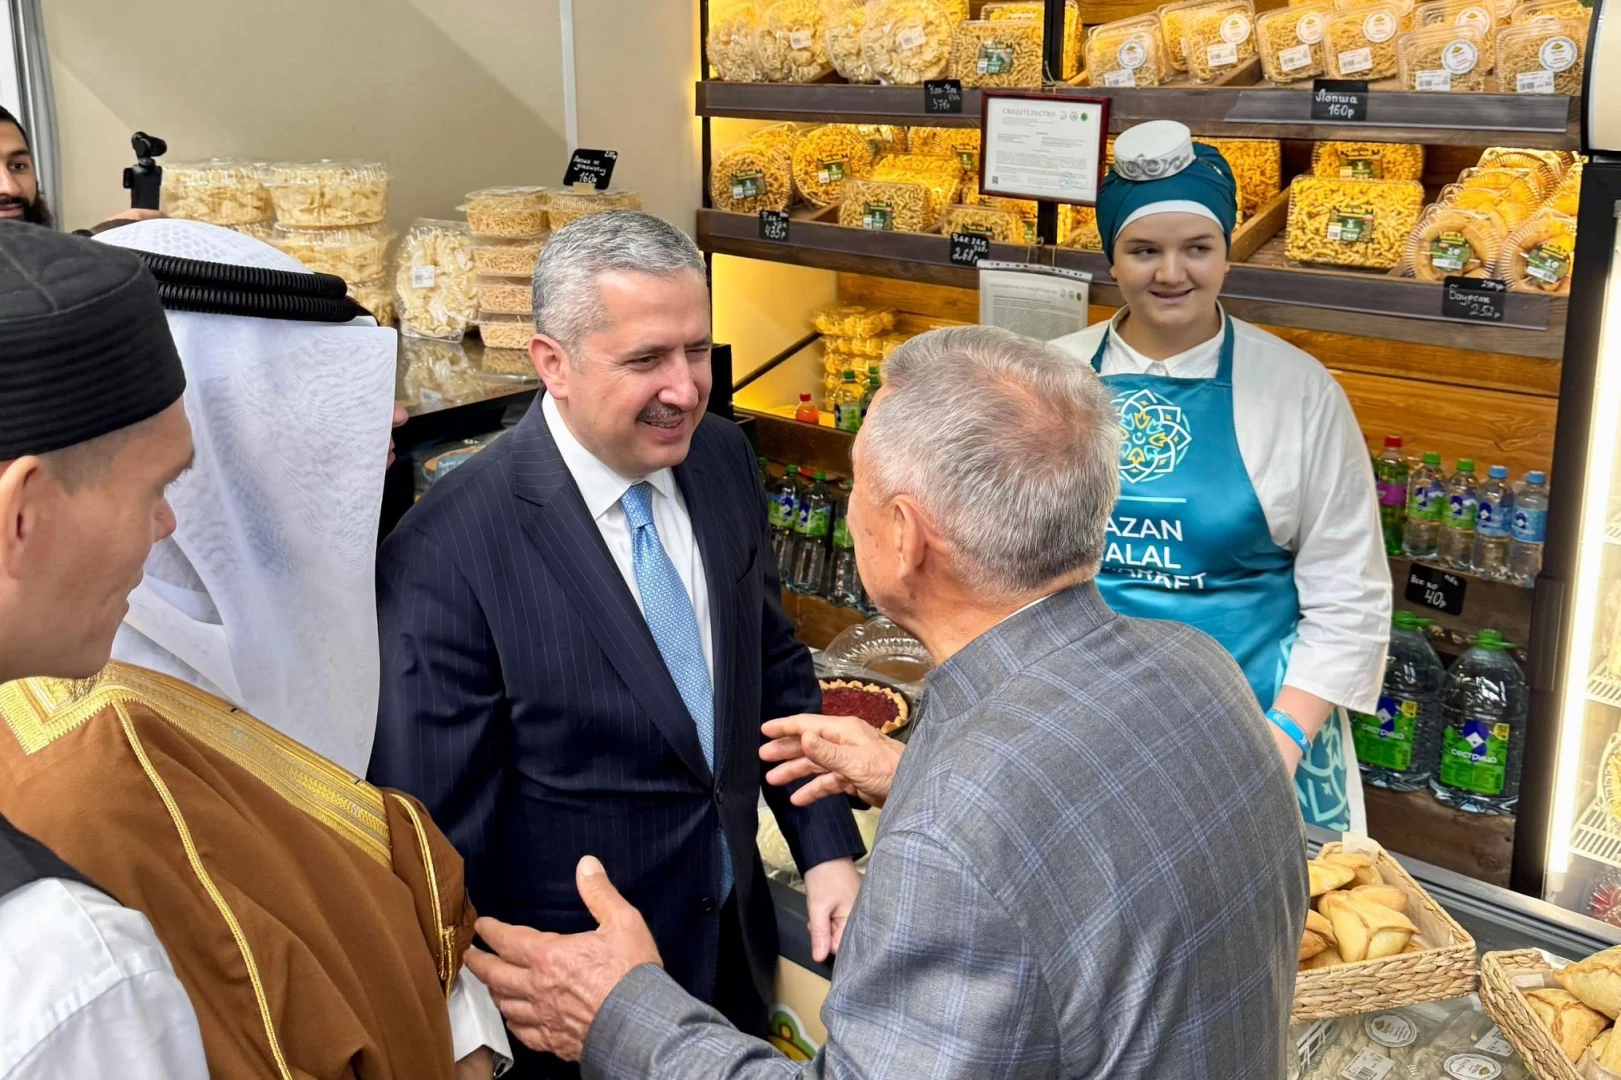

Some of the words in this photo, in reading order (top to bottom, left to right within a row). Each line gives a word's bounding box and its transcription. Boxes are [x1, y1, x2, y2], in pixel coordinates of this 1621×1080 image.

[1002, 107, 1056, 118] СВИДЕТЕЛЬСТВО
[1328, 103, 1355, 119] 160р
[1104, 516, 1183, 541] AZAN
[1101, 543, 1182, 568] ALAL
